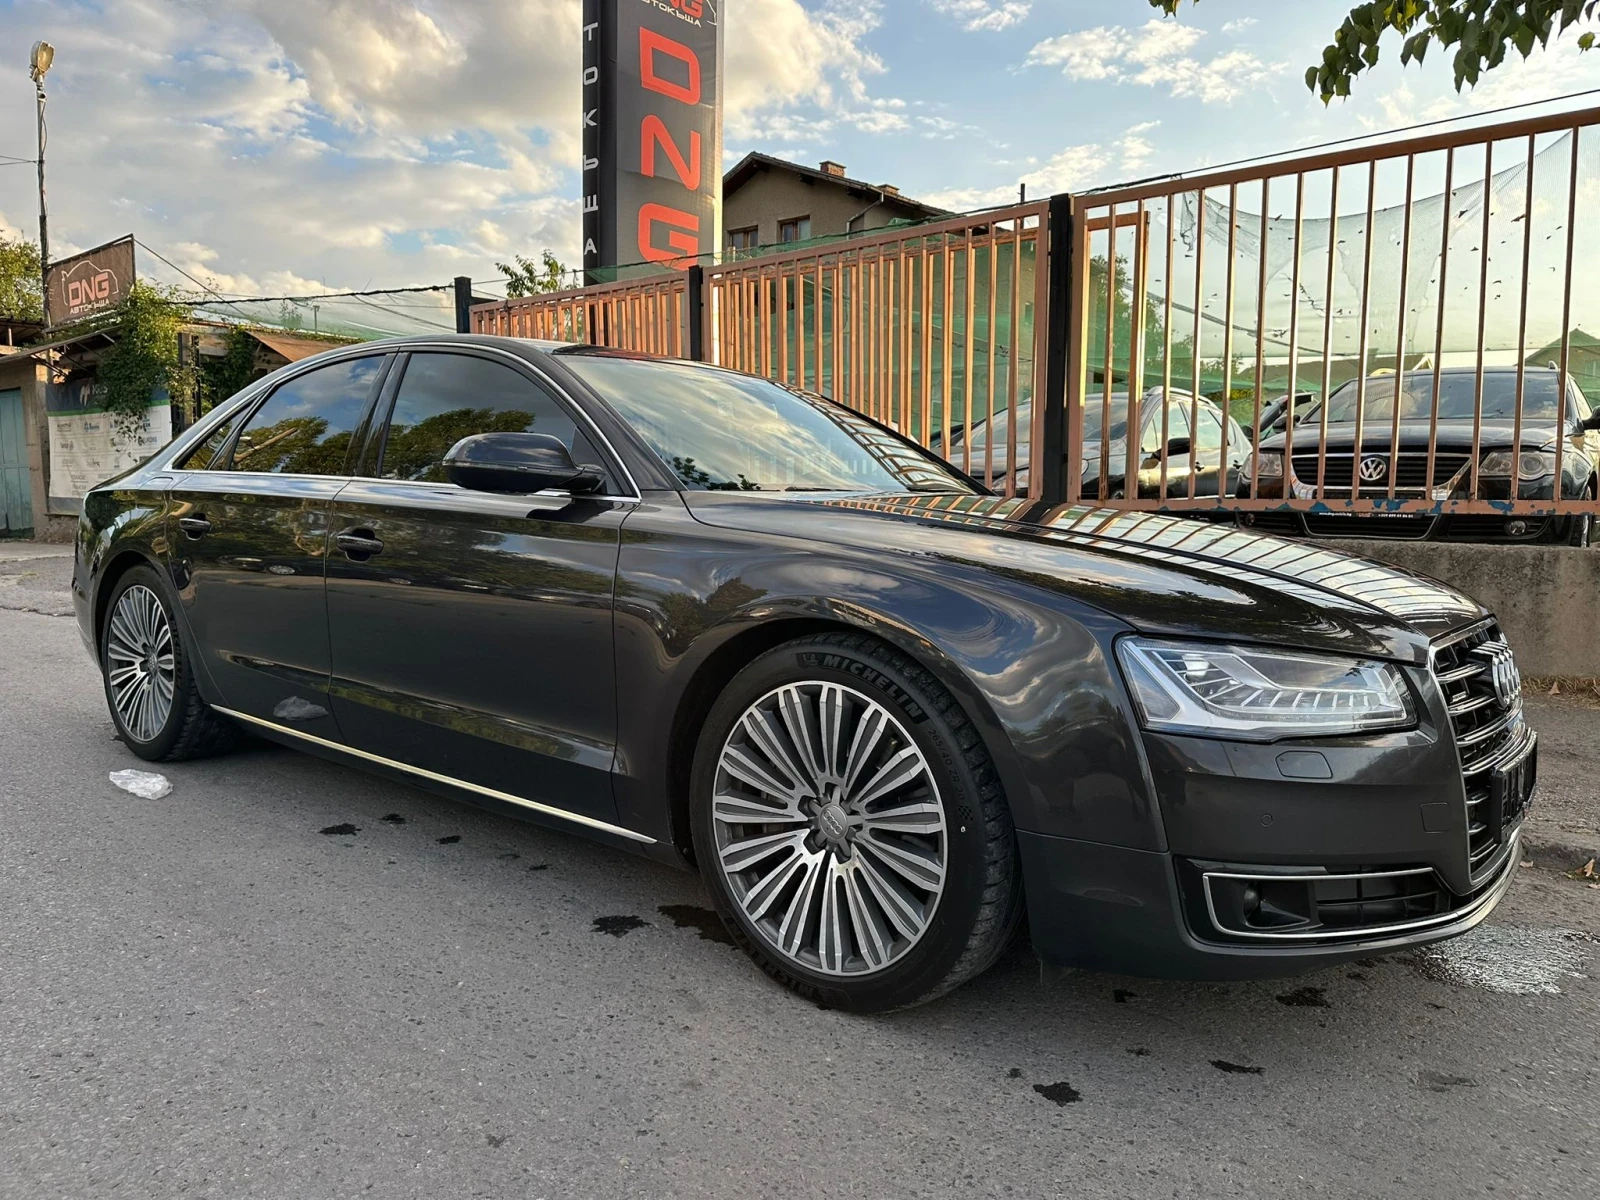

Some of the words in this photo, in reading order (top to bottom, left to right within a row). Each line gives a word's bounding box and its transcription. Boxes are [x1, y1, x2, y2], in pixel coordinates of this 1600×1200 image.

[638, 26, 701, 271] DNG
[68, 272, 110, 306] DNG
[1359, 457, 1387, 480] VW
[822, 654, 923, 719] MICHELIN
[927, 729, 953, 766] 265/40
[948, 766, 960, 783] ZR
[955, 785, 966, 801] 20
